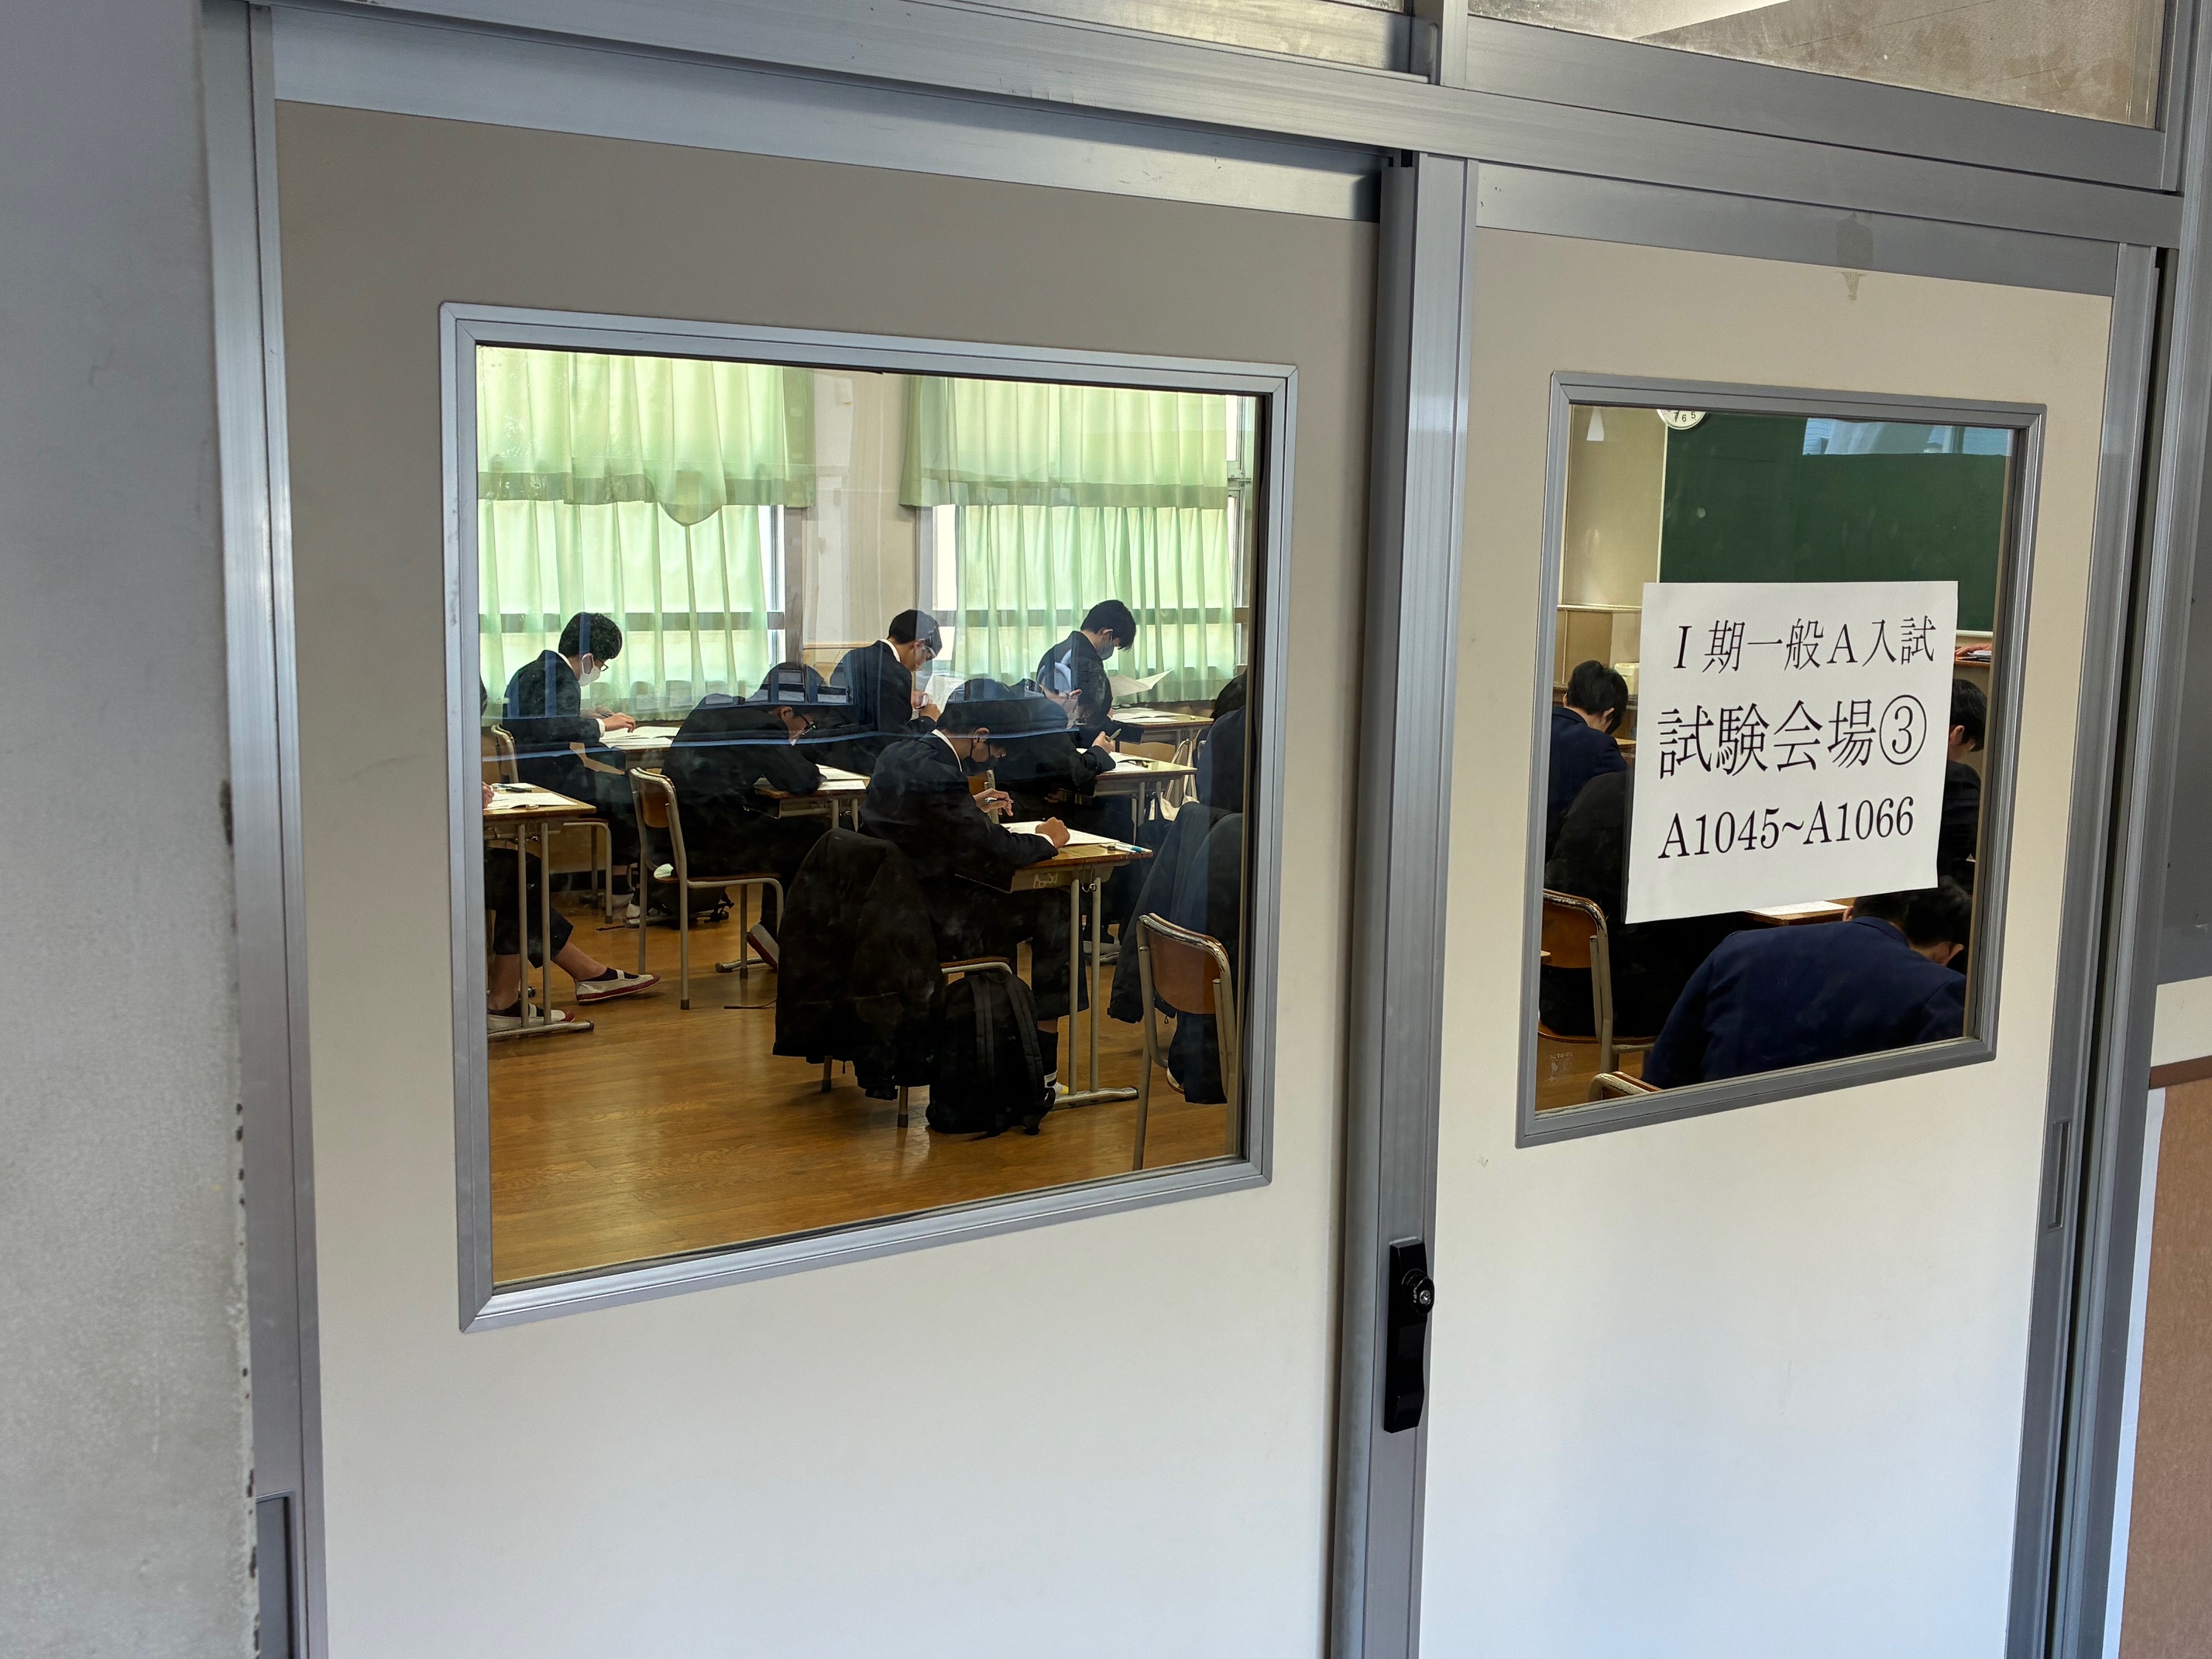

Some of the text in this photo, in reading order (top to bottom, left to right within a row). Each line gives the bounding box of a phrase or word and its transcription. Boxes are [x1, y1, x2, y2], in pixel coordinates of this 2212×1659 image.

[1681, 414, 1687, 422] 6
[1657, 694, 1927, 780] 試験会場③
[1657, 795, 1914, 859] A1045~A1066
